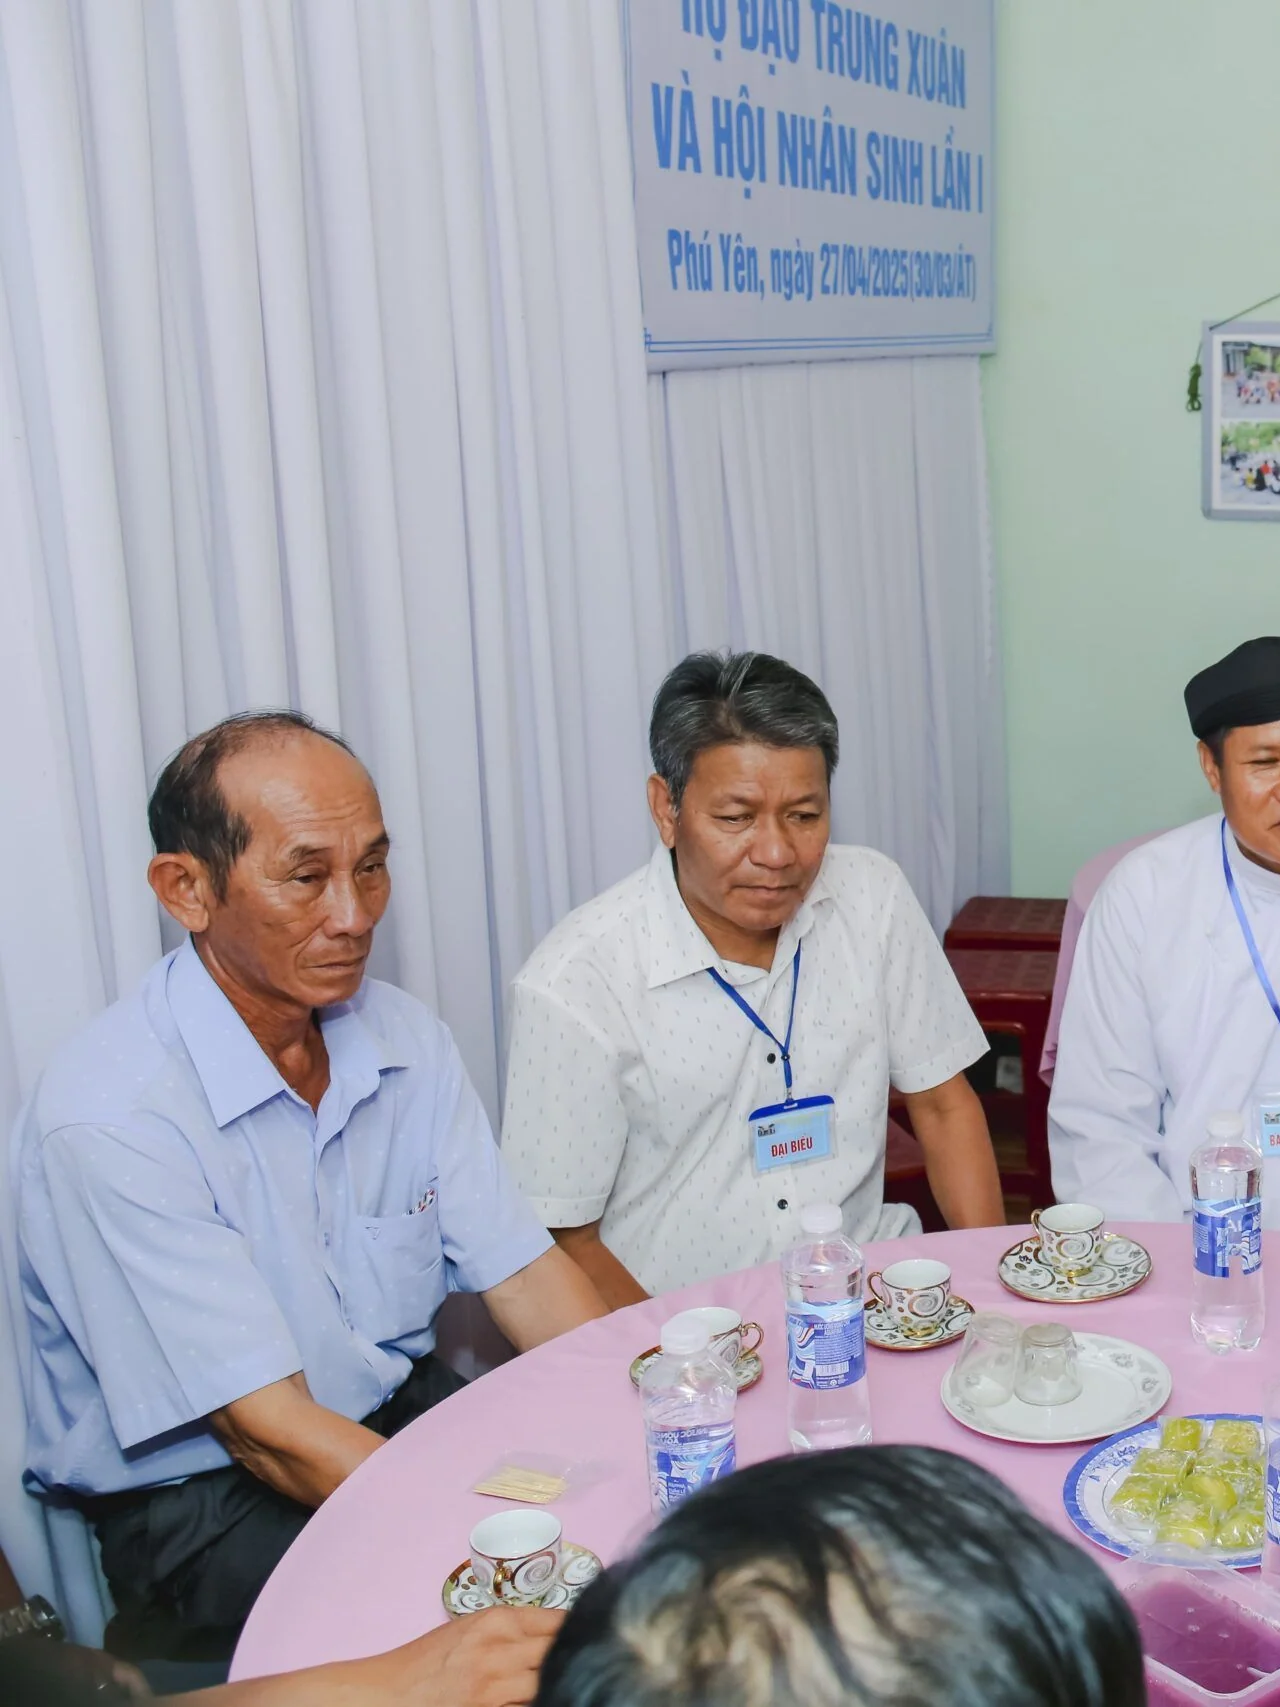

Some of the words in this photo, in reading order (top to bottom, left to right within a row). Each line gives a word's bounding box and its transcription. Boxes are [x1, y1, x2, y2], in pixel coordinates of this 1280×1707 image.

[810, 0, 899, 92] TRUNG
[907, 27, 967, 110] XUÂN
[651, 69, 703, 174] VÀ
[712, 84, 767, 200] HỘI
[777, 105, 858, 197] NHÂN
[866, 131, 924, 206] SINH
[977, 154, 984, 214] I
[667, 228, 713, 292] Phú
[719, 233, 765, 300] Yên,
[770, 238, 815, 301] ngày
